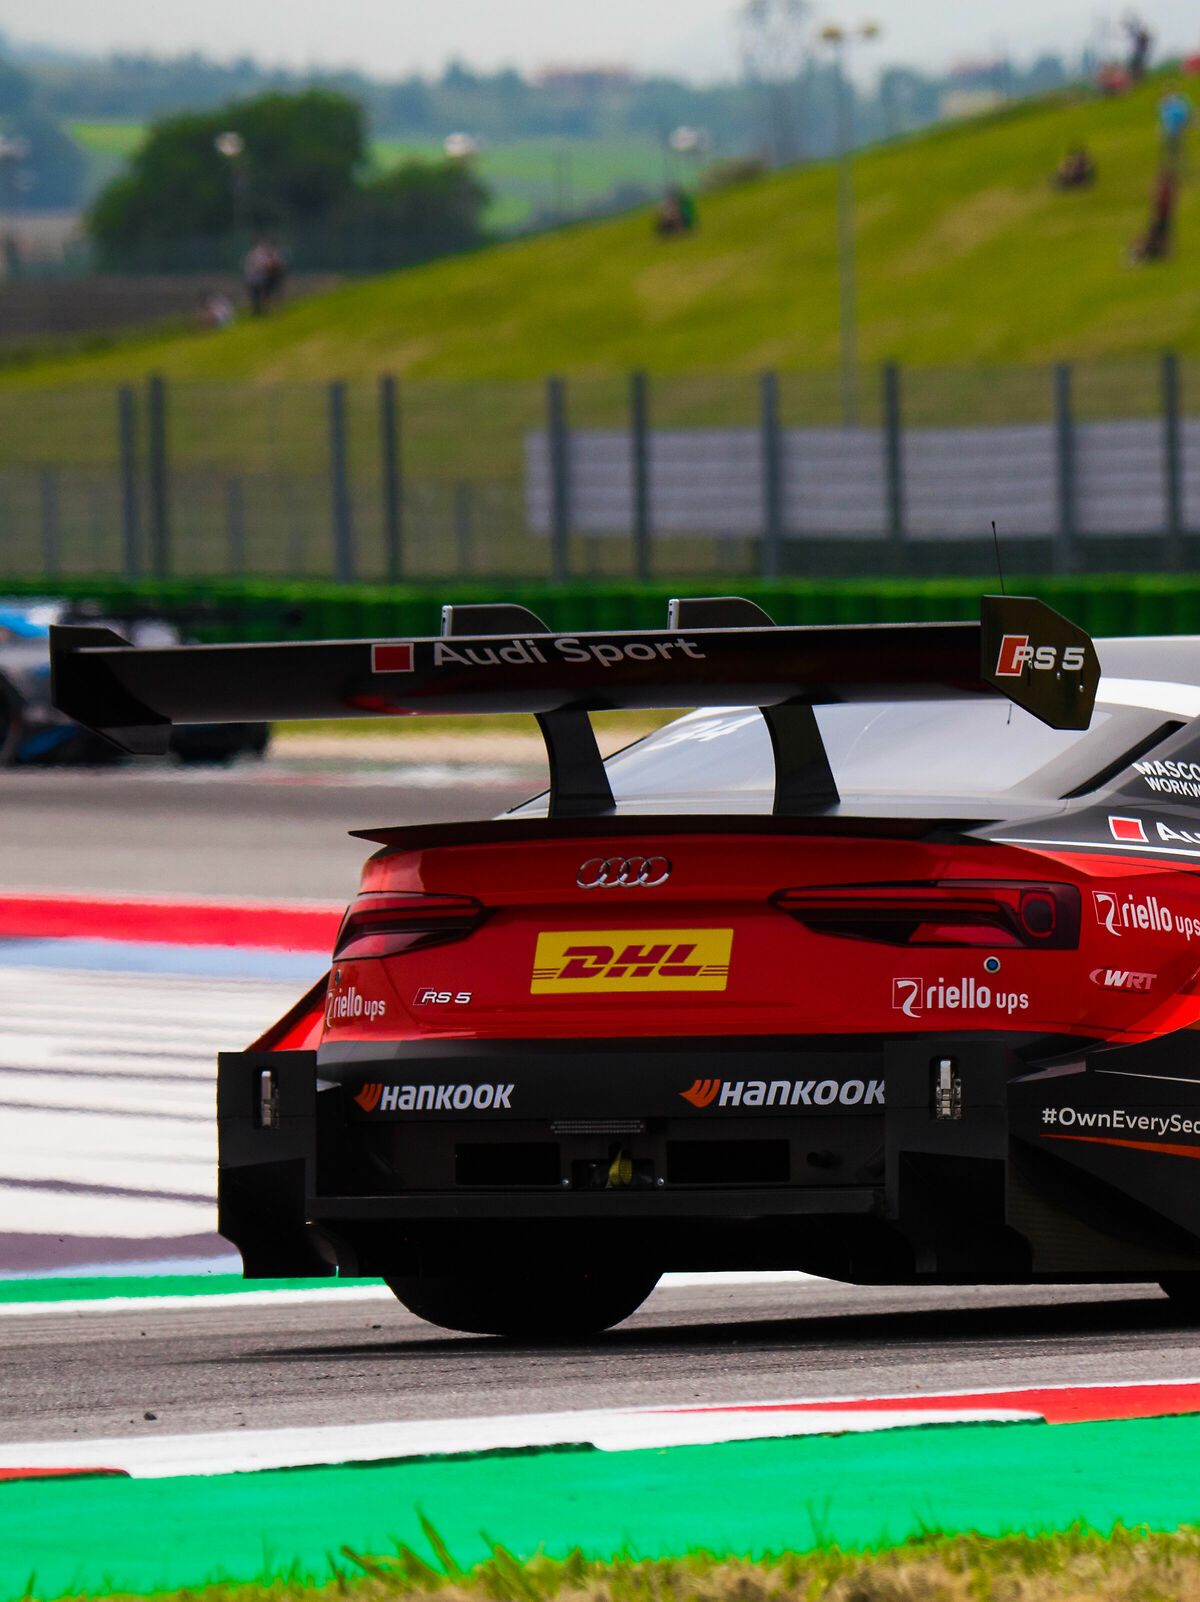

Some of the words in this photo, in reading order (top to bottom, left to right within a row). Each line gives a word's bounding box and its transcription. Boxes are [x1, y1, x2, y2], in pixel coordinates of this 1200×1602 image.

[434, 639, 547, 666] Audi
[553, 638, 706, 667] Sport
[1011, 646, 1058, 670] RS
[1062, 647, 1085, 671] 5
[1122, 894, 1172, 932] riello
[557, 943, 704, 980] DHL
[1104, 969, 1158, 990] WRT
[333, 986, 363, 1018] riello
[364, 1000, 386, 1022] ups
[421, 991, 451, 1004] RS
[454, 991, 472, 1004] 5
[926, 977, 992, 1009] riello
[996, 992, 1029, 1015] ups
